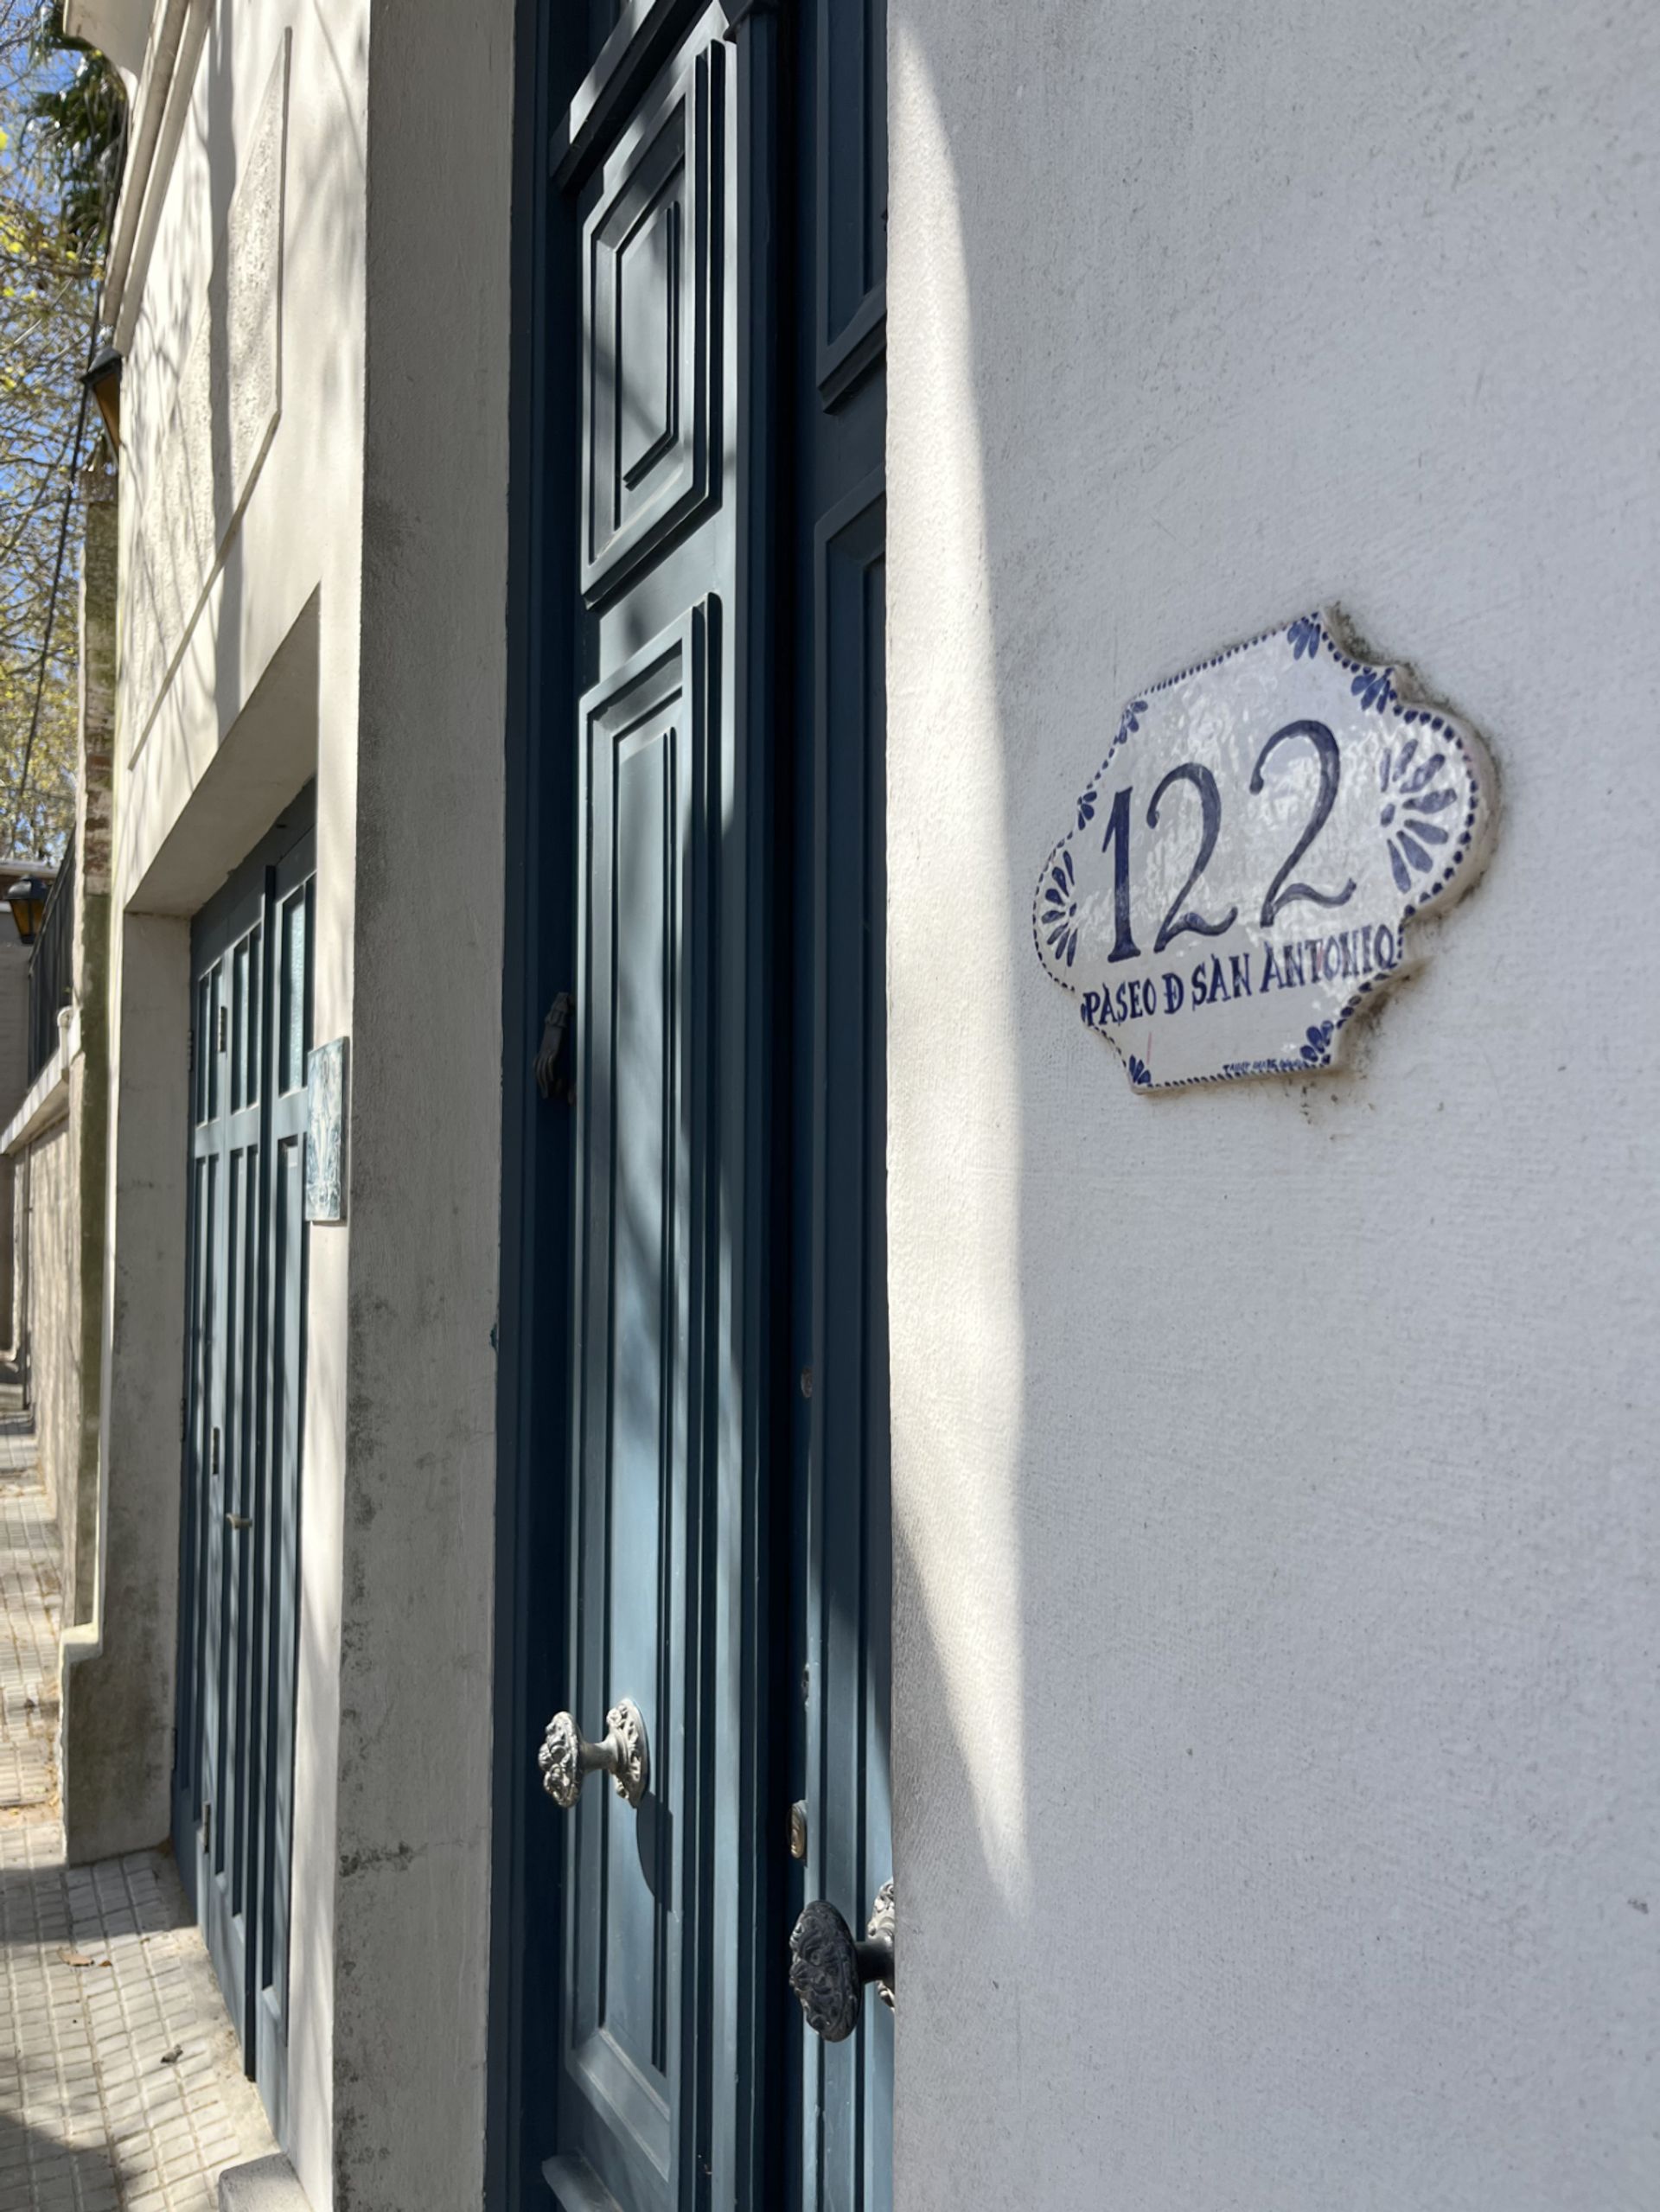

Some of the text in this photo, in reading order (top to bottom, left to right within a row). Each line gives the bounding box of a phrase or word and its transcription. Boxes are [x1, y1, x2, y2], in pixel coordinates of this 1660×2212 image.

[1102, 719, 1357, 963] 122
[1083, 978, 1157, 1027] PASEO
[1191, 953, 1252, 1011] SAN
[1260, 924, 1395, 993] ANTONIO
